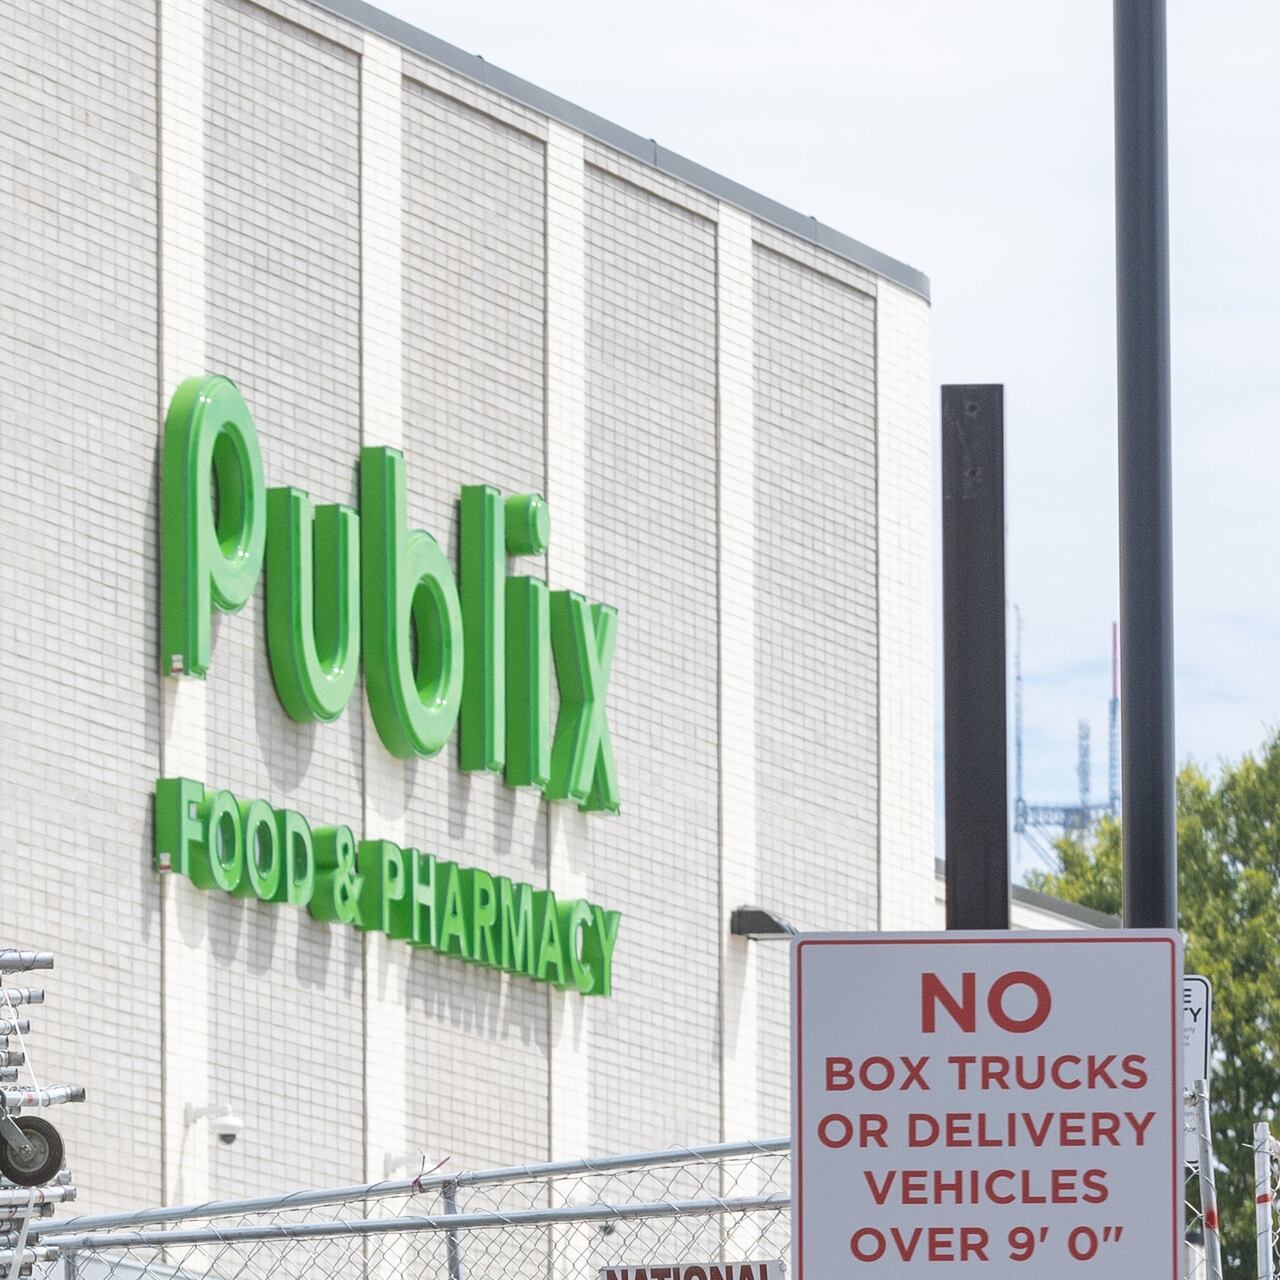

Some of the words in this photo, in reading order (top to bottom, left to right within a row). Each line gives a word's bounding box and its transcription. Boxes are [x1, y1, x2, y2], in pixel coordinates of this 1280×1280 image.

[162, 373, 621, 815] Publix
[155, 777, 316, 907] FOOD
[309, 824, 365, 927] &
[358, 839, 622, 997] PHARMACY
[921, 971, 1053, 1034] NO
[825, 1056, 931, 1092] BOX
[949, 1055, 1149, 1091] TRUCKS
[818, 1113, 890, 1150] OR
[908, 1112, 1156, 1149] DELIVERY
[864, 1168, 1110, 1206] VEHICLES
[851, 1227, 990, 1263] OVER
